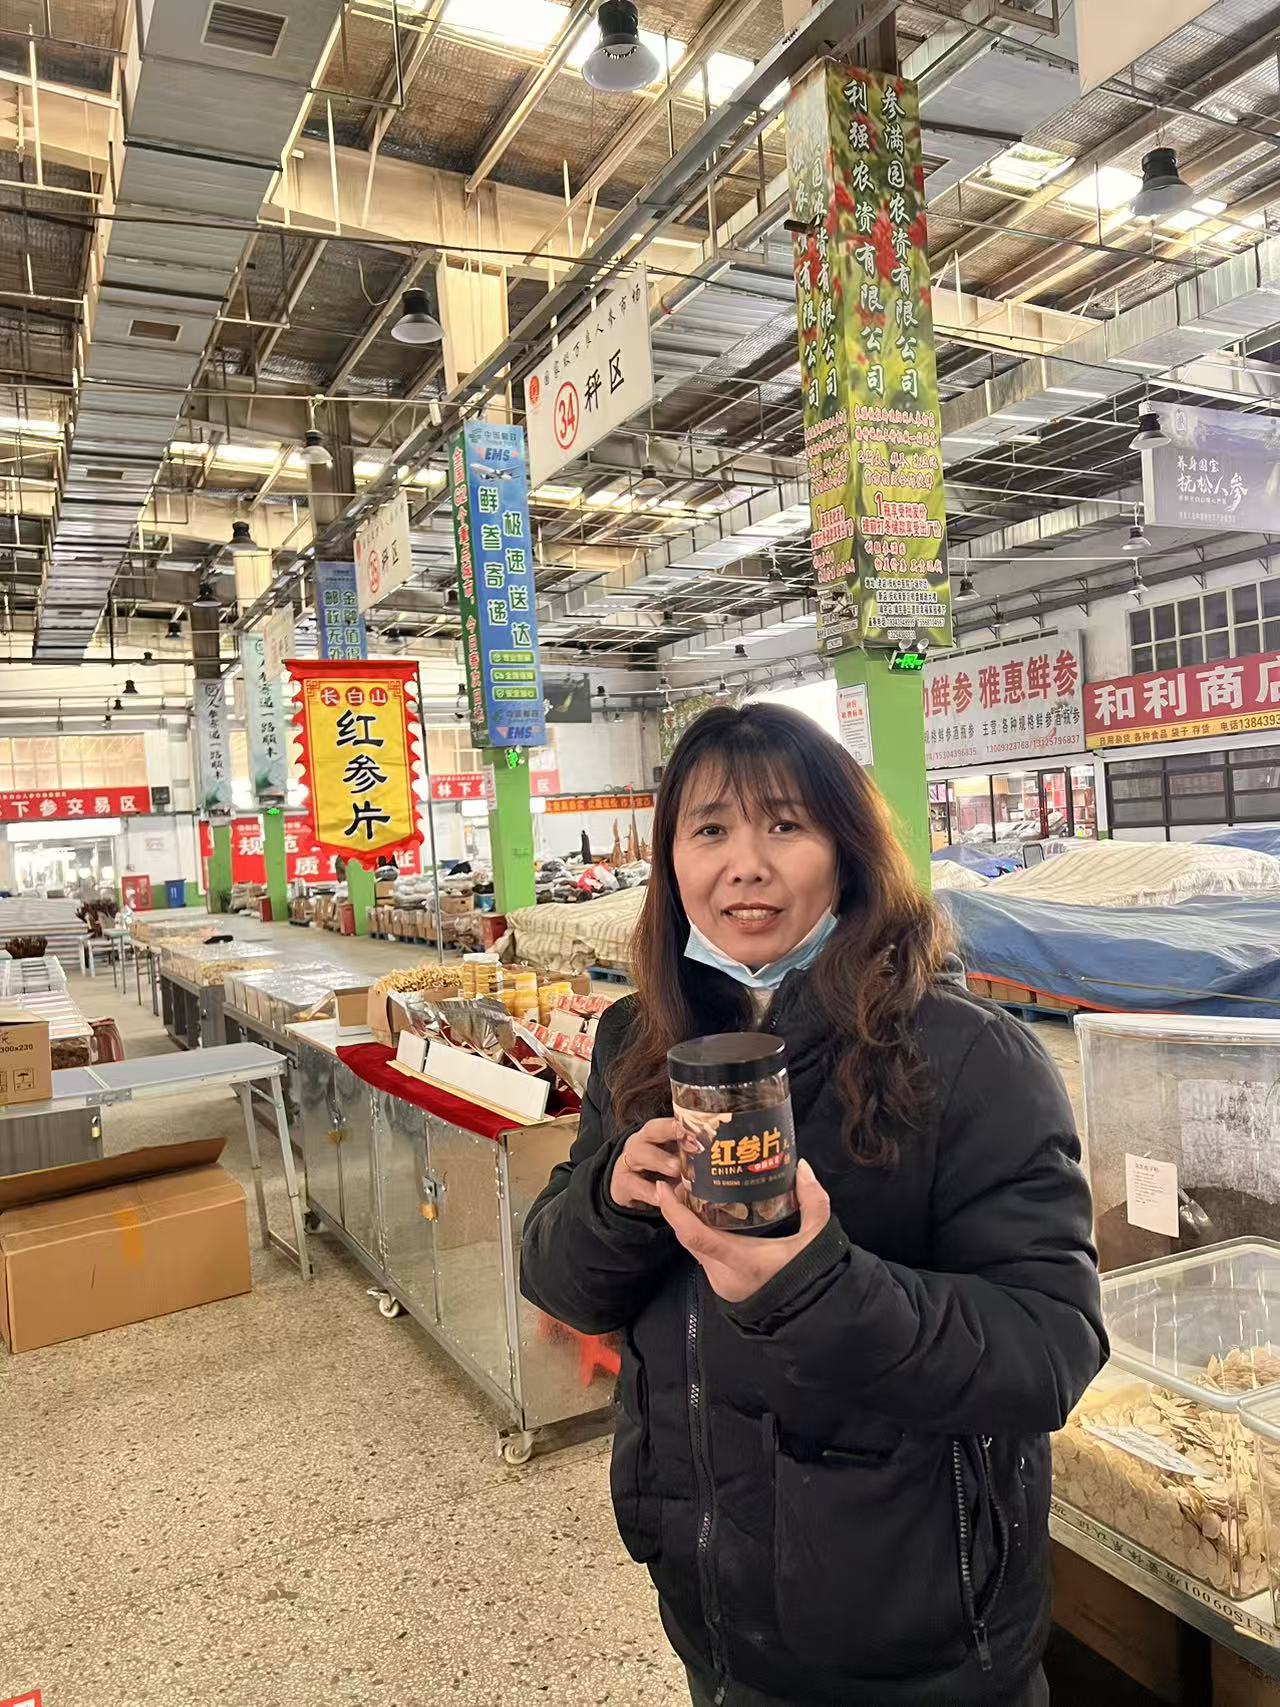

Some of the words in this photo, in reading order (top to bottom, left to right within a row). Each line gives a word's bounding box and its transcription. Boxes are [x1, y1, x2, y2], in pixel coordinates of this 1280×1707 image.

[844, 80, 886, 398] 利强农资有限公司
[882, 85, 919, 400] 参满园农资有限公司
[485, 447, 511, 461] EMS
[476, 484, 508, 628] 鲜参寄递
[502, 510, 532, 650] 极速送达
[320, 687, 388, 705] 长白山
[978, 649, 1078, 710] 雅惠鲜参
[508, 726, 534, 740] EMS
[1134, 727, 1169, 742] 各种食品
[334, 709, 391, 842] 红参片
[0, 795, 138, 818] 下参交易区
[710, 1126, 782, 1166] 红参片
[711, 1166, 743, 1176] CHINA
